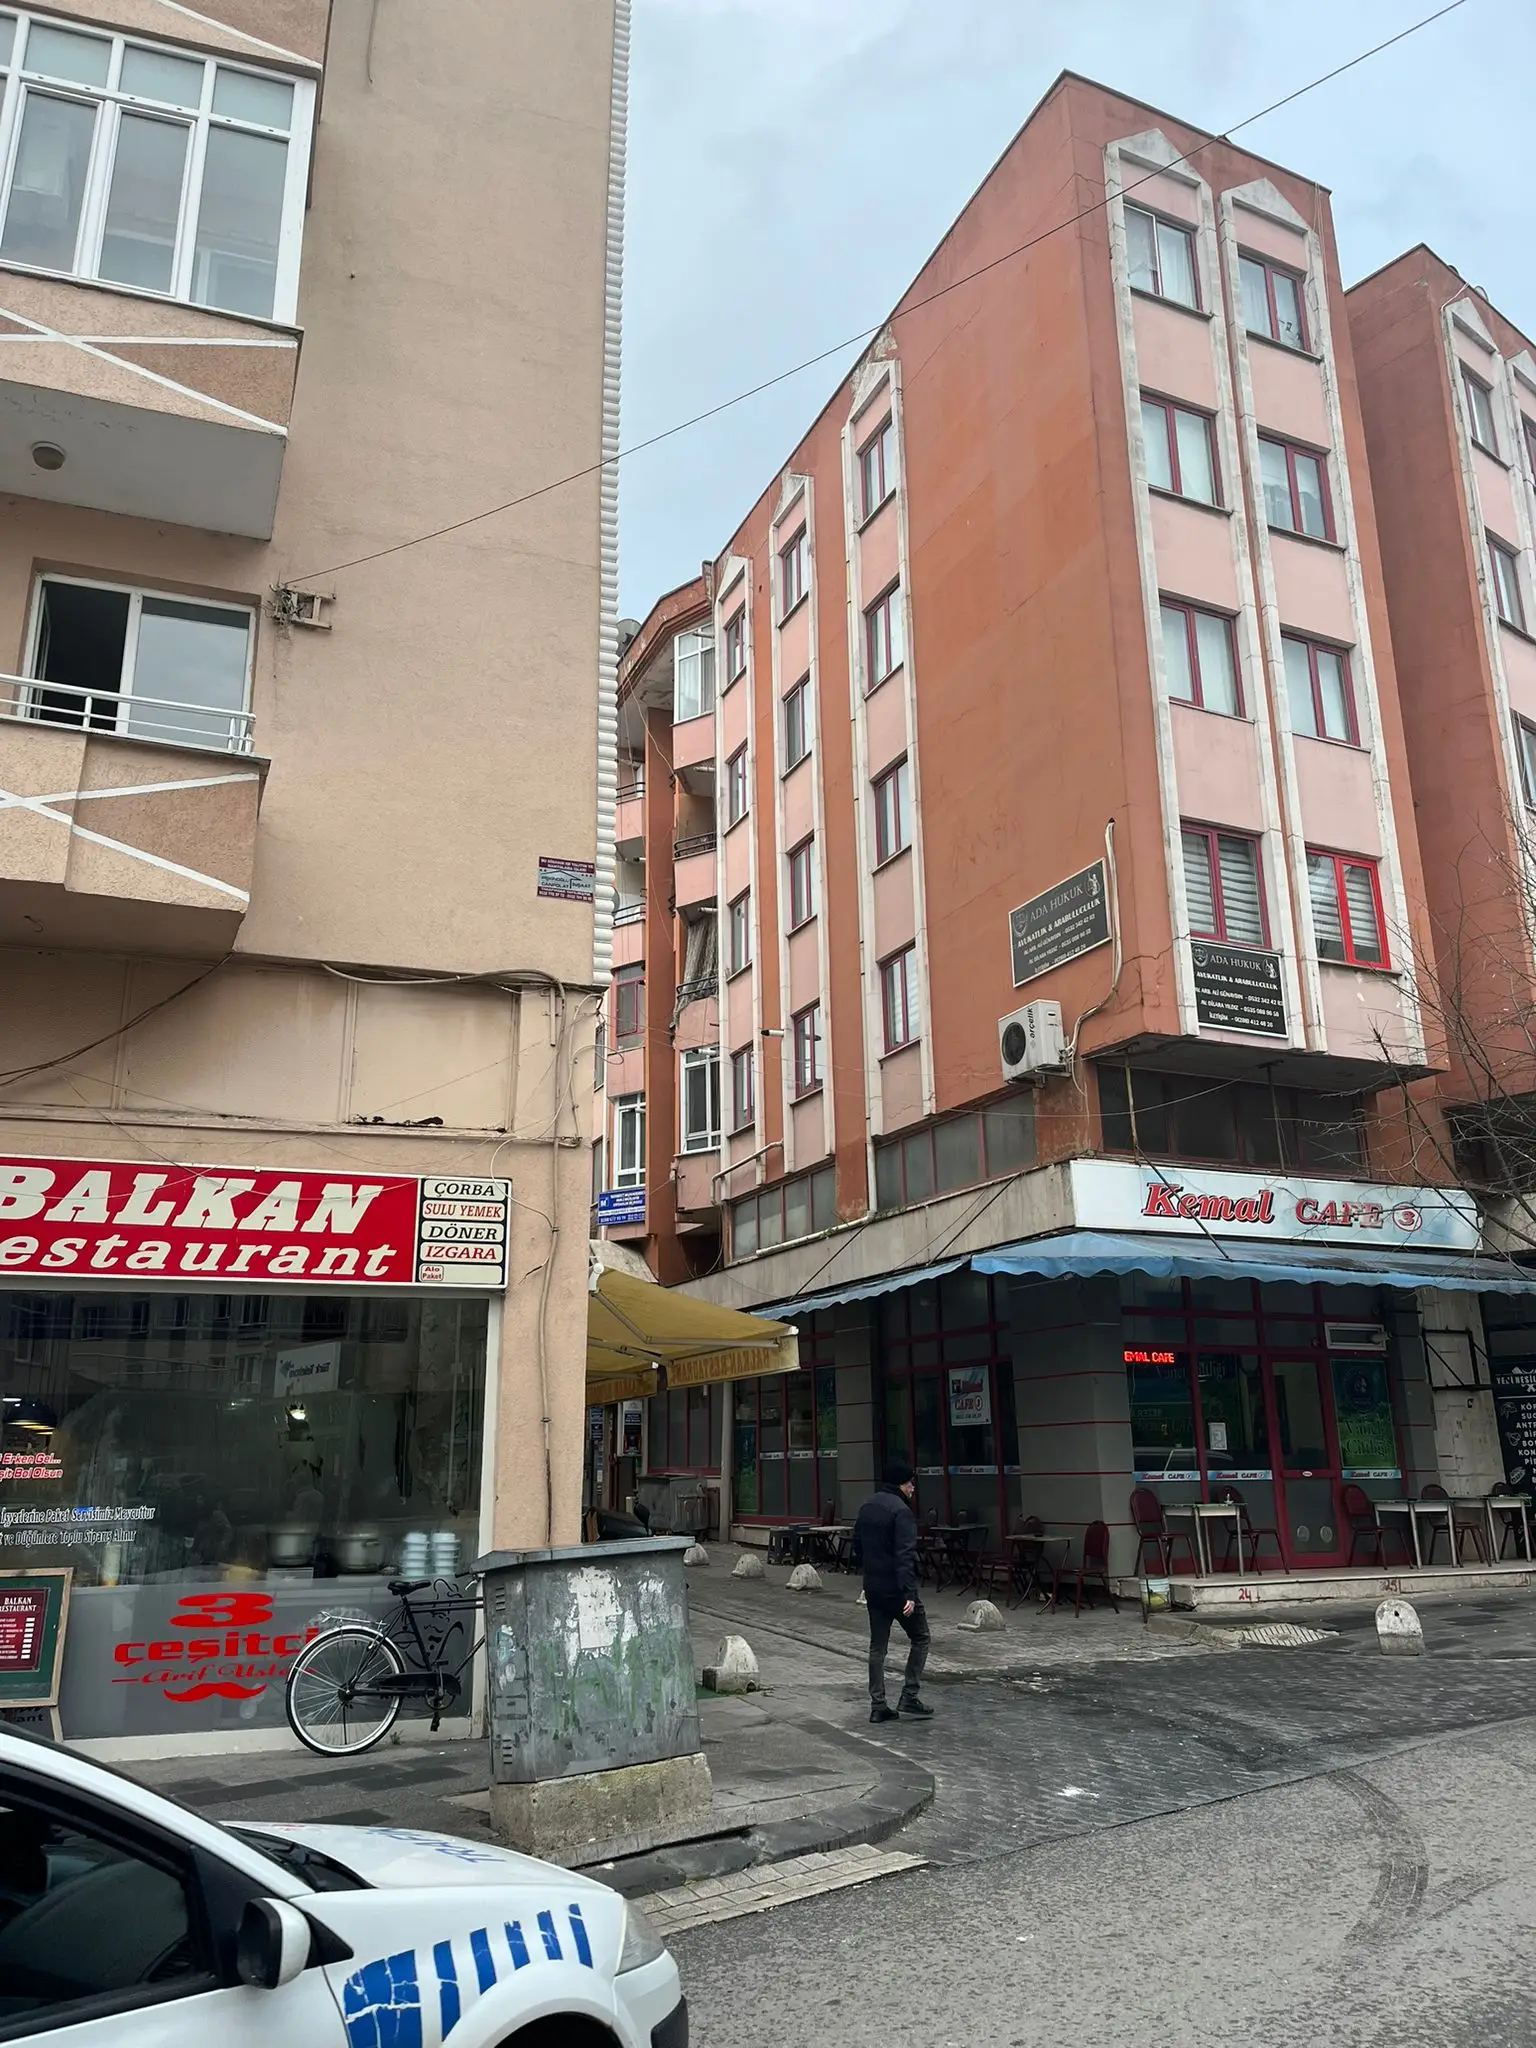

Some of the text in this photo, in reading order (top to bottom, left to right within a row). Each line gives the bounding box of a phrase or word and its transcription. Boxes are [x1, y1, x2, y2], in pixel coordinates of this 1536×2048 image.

[1030, 884, 1084, 922] ADA HUKUK
[1210, 955, 1262, 971] ADA HUKUK
[1196, 971, 1228, 982] AVUKATLIK
[1234, 978, 1278, 990] ARABULUCULUK
[1027, 1008, 1036, 1038] arçelik
[434, 1182, 495, 1197] ÇORBA
[0, 1165, 385, 1234] BALKAN
[1141, 1182, 1276, 1225] Kemal
[1295, 1198, 1385, 1229] CAFE
[424, 1202, 502, 1218] SULU YEMEK
[427, 1222, 498, 1240] DÖNER
[0, 1234, 398, 1277] estaurant
[425, 1245, 497, 1260] IZGARA
[422, 1272, 442, 1280] Paket
[1124, 1350, 1174, 1364] EMAL CAFE
[1496, 1374, 1514, 1385] YENİ
[2, 1453, 34, 1465] Erken
[14, 1468, 32, 1479] Bol
[32, 1468, 64, 1479] Olsun
[1241, 1472, 1258, 1480] CAFE
[46, 1508, 70, 1523] Paket
[71, 1506, 114, 1522] Servisimiz
[114, 1506, 156, 1521] Mevcuttur
[16, 1529, 59, 1548] Düğünlere
[60, 1530, 82, 1546] Toplu
[84, 1529, 113, 1546] Sipariş
[114, 1528, 137, 1543] Alınır
[4, 1597, 32, 1605] BALKAN
[169, 1592, 273, 1628] 3
